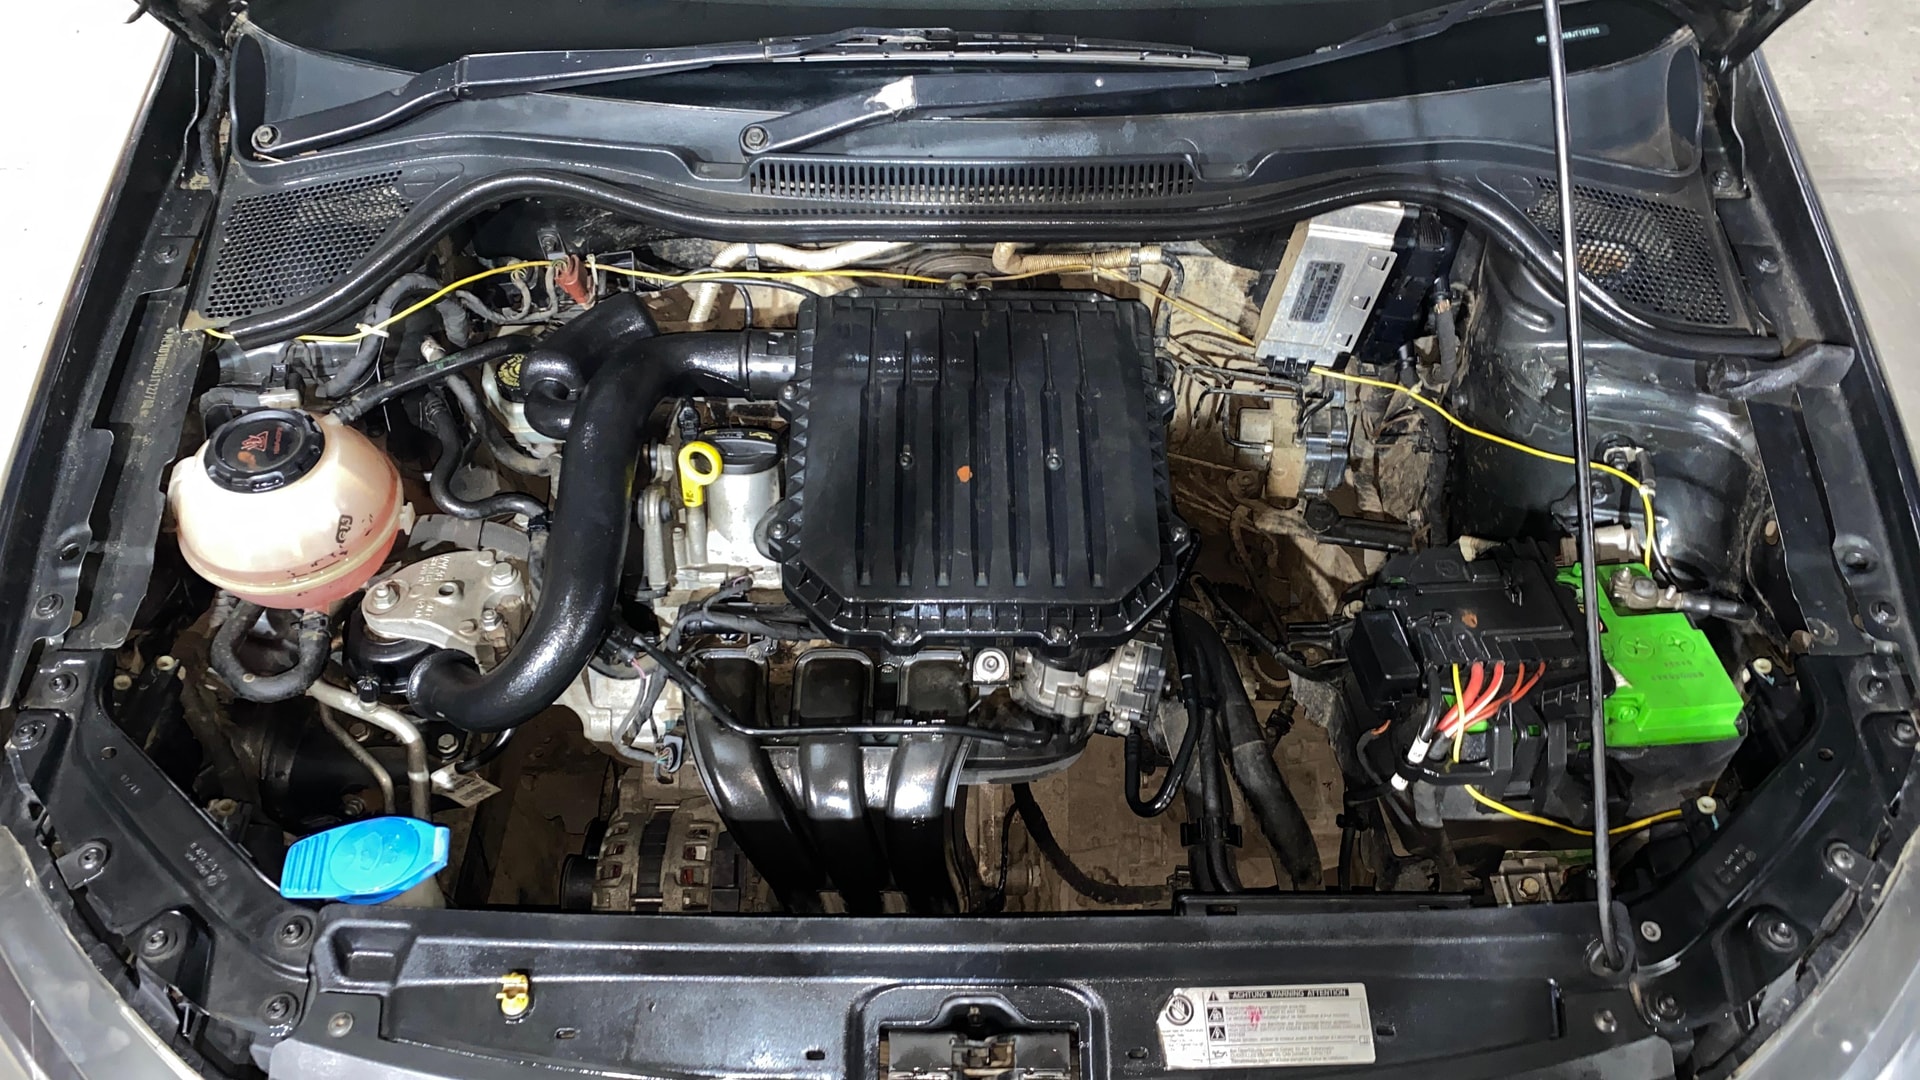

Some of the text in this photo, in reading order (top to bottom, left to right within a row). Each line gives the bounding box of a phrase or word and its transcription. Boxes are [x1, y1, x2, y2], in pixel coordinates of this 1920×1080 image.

[1232, 989, 1346, 999] ACHTUNG WARNING ATTENTION
